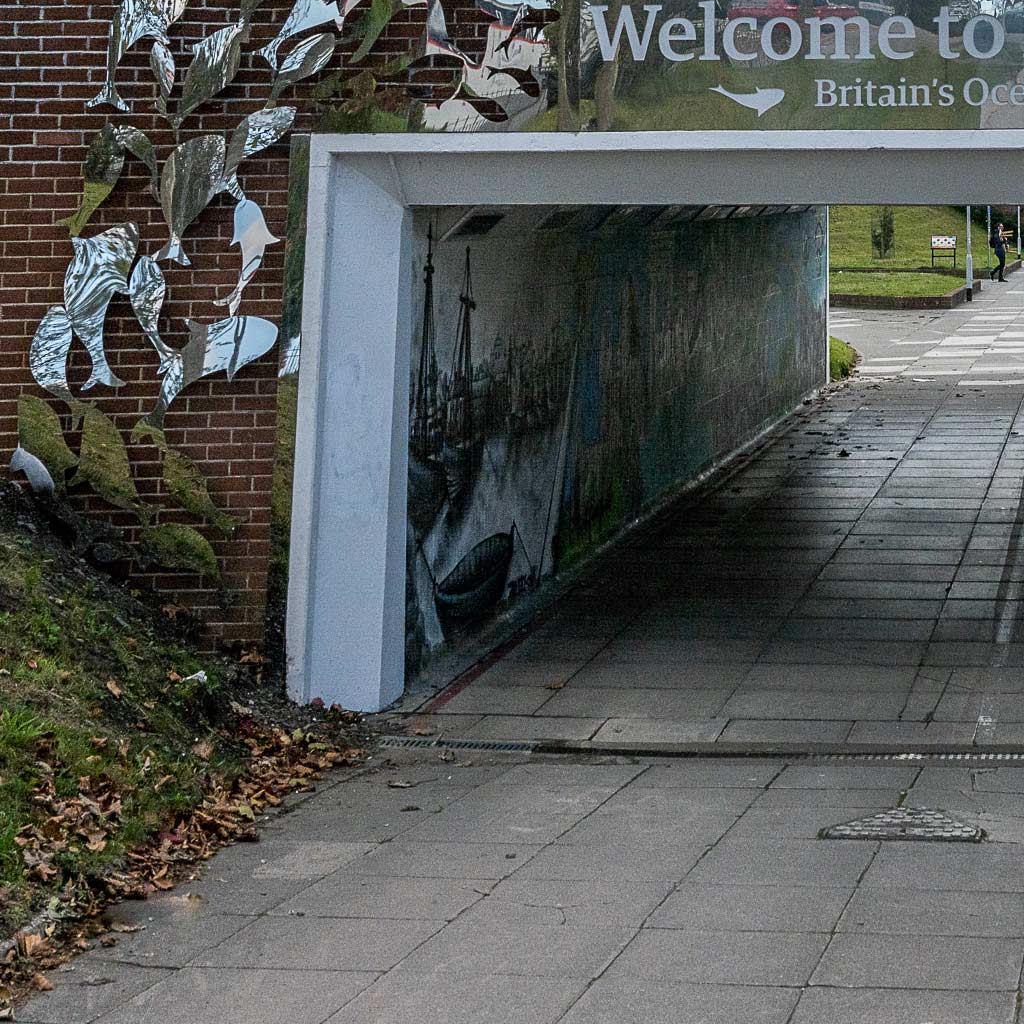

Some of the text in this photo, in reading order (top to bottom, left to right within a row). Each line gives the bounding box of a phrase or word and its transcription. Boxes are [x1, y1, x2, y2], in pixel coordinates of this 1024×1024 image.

[585, 0, 917, 62] Welcome
[933, 9, 1004, 61] to
[814, 79, 955, 108] Britain's
